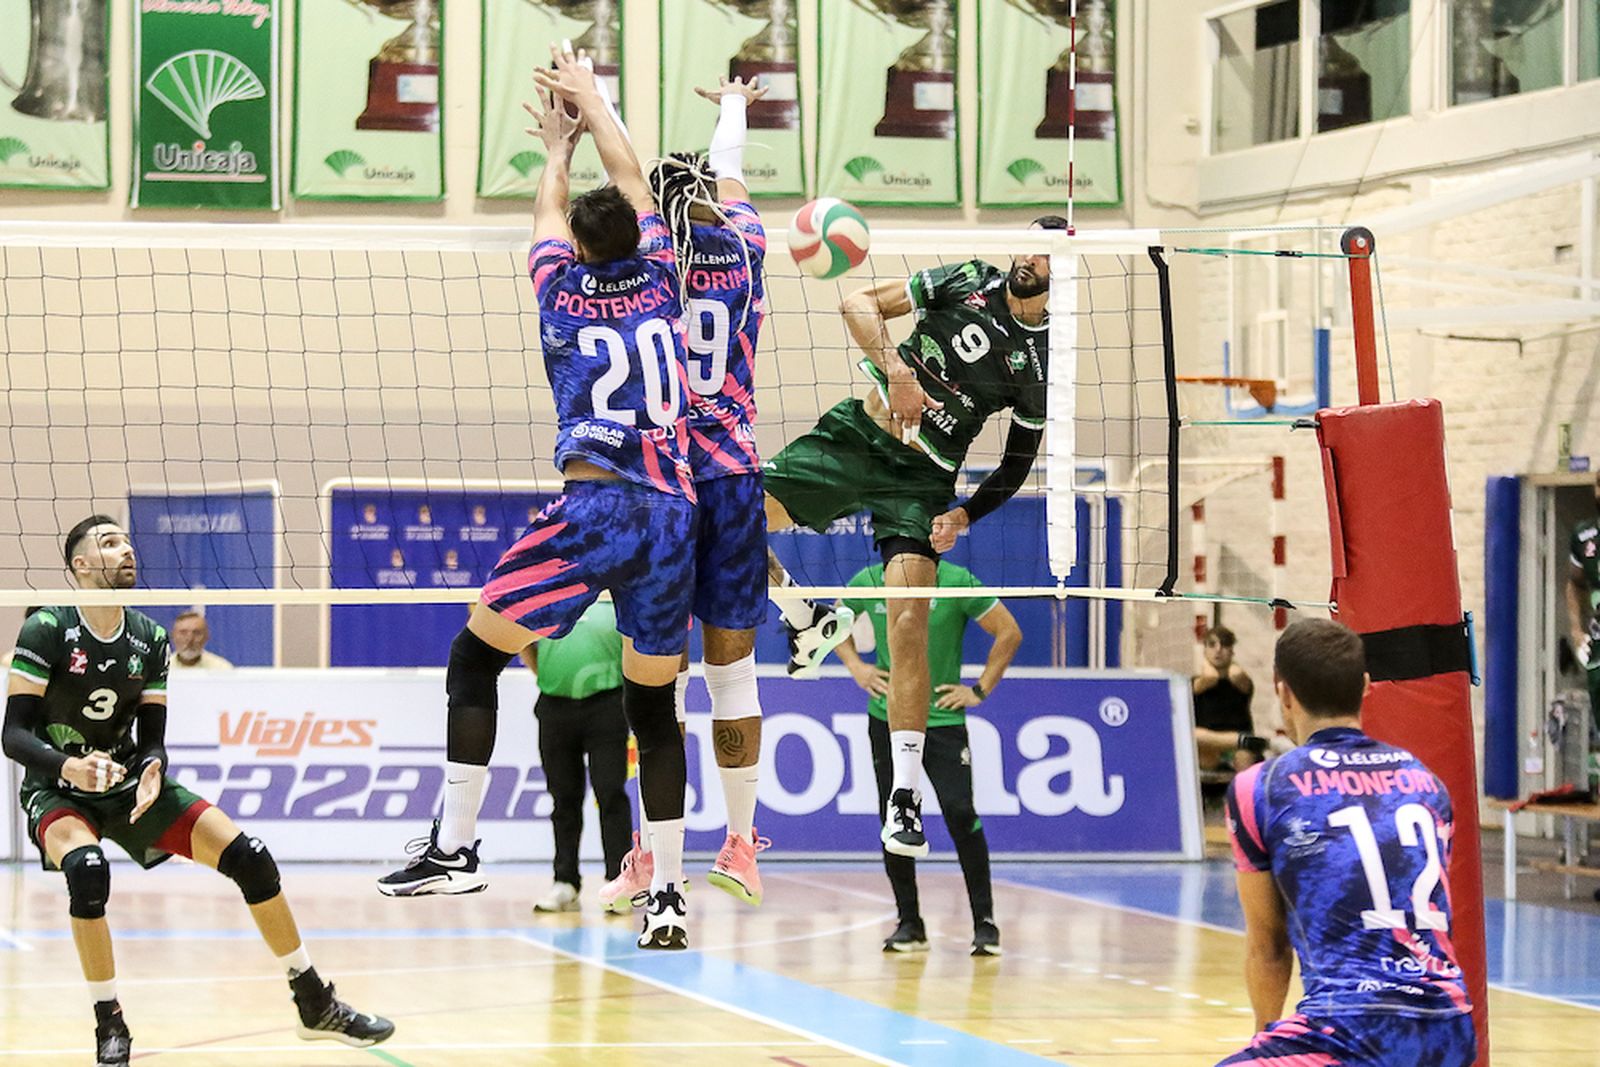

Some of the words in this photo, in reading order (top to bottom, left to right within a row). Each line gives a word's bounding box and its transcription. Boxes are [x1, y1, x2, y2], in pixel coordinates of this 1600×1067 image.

[28, 153, 81, 172] Unicaja
[152, 140, 257, 177] Unicaja
[363, 165, 416, 182] Unicaja
[741, 163, 778, 180] nicaja
[882, 168, 932, 187] Unicaja
[1043, 173, 1094, 189] Uniaja
[553, 276, 675, 319] POSTEMSKY
[687, 298, 730, 396] 9
[952, 323, 992, 364] 9
[577, 317, 682, 428] 20
[588, 431, 623, 449] VISION
[589, 425, 626, 441] SOLAR
[81, 687, 119, 721] 3
[218, 711, 378, 757] Viajes
[683, 711, 1126, 832] joma
[1288, 768, 1439, 797] V.MONFORT
[1327, 803, 1450, 930] 12
